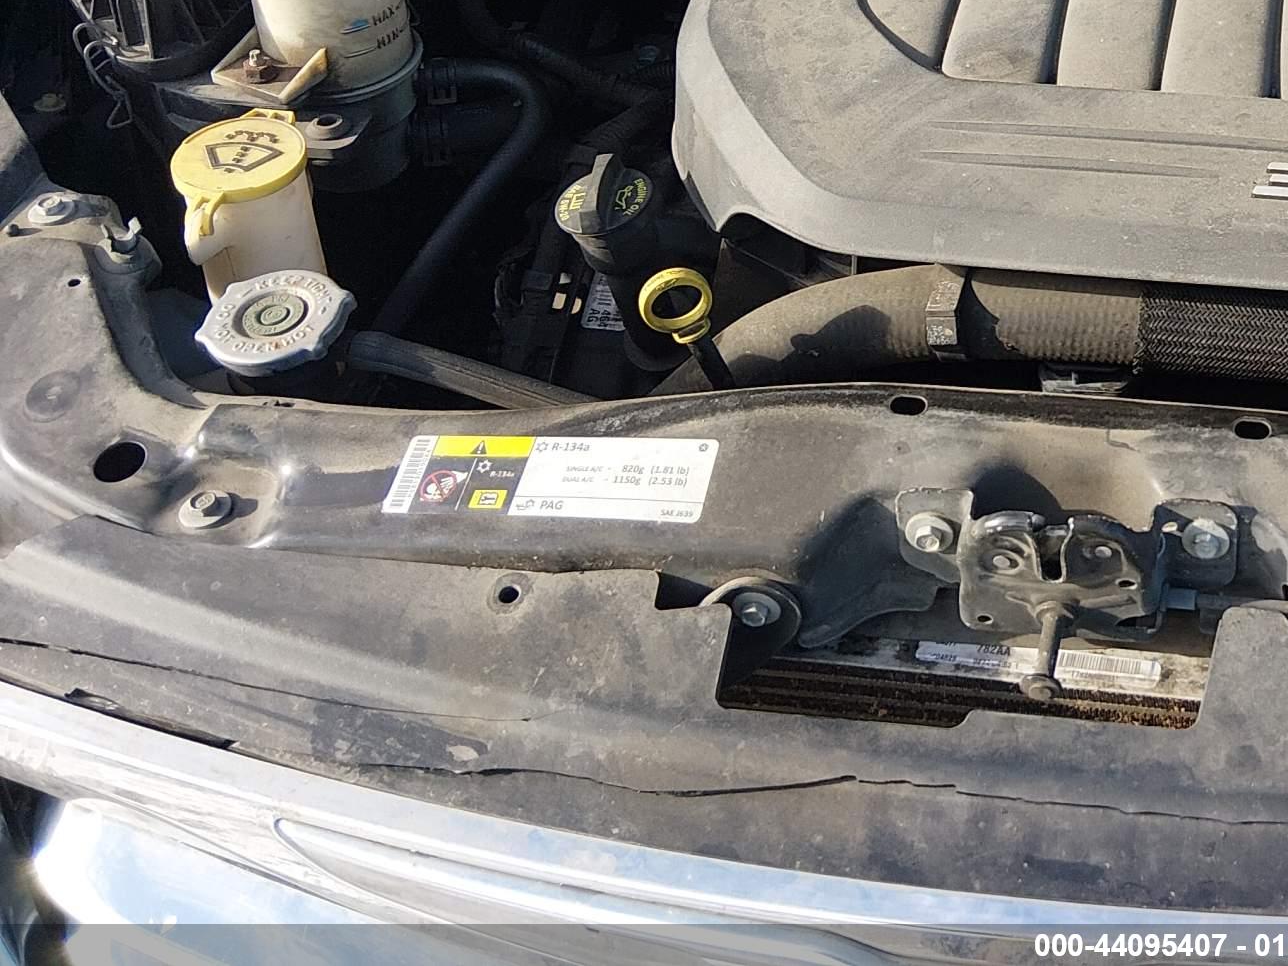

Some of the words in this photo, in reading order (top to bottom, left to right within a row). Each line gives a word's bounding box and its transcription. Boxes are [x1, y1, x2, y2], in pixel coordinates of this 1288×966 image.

[372, 4, 395, 26] MAX
[376, 27, 400, 49] MIN
[633, 178, 649, 203] ENGINE
[623, 204, 640, 217] OIL
[254, 276, 304, 291] KEEP
[232, 340, 280, 355] OPEN
[280, 323, 315, 348] HOT
[551, 441, 590, 452] R-134a
[621, 464, 644, 475] 820g
[613, 475, 641, 486] 1150g
[540, 500, 564, 511] PAG
[660, 509, 675, 517] SAE
[977, 642, 1011, 657] 782AA
